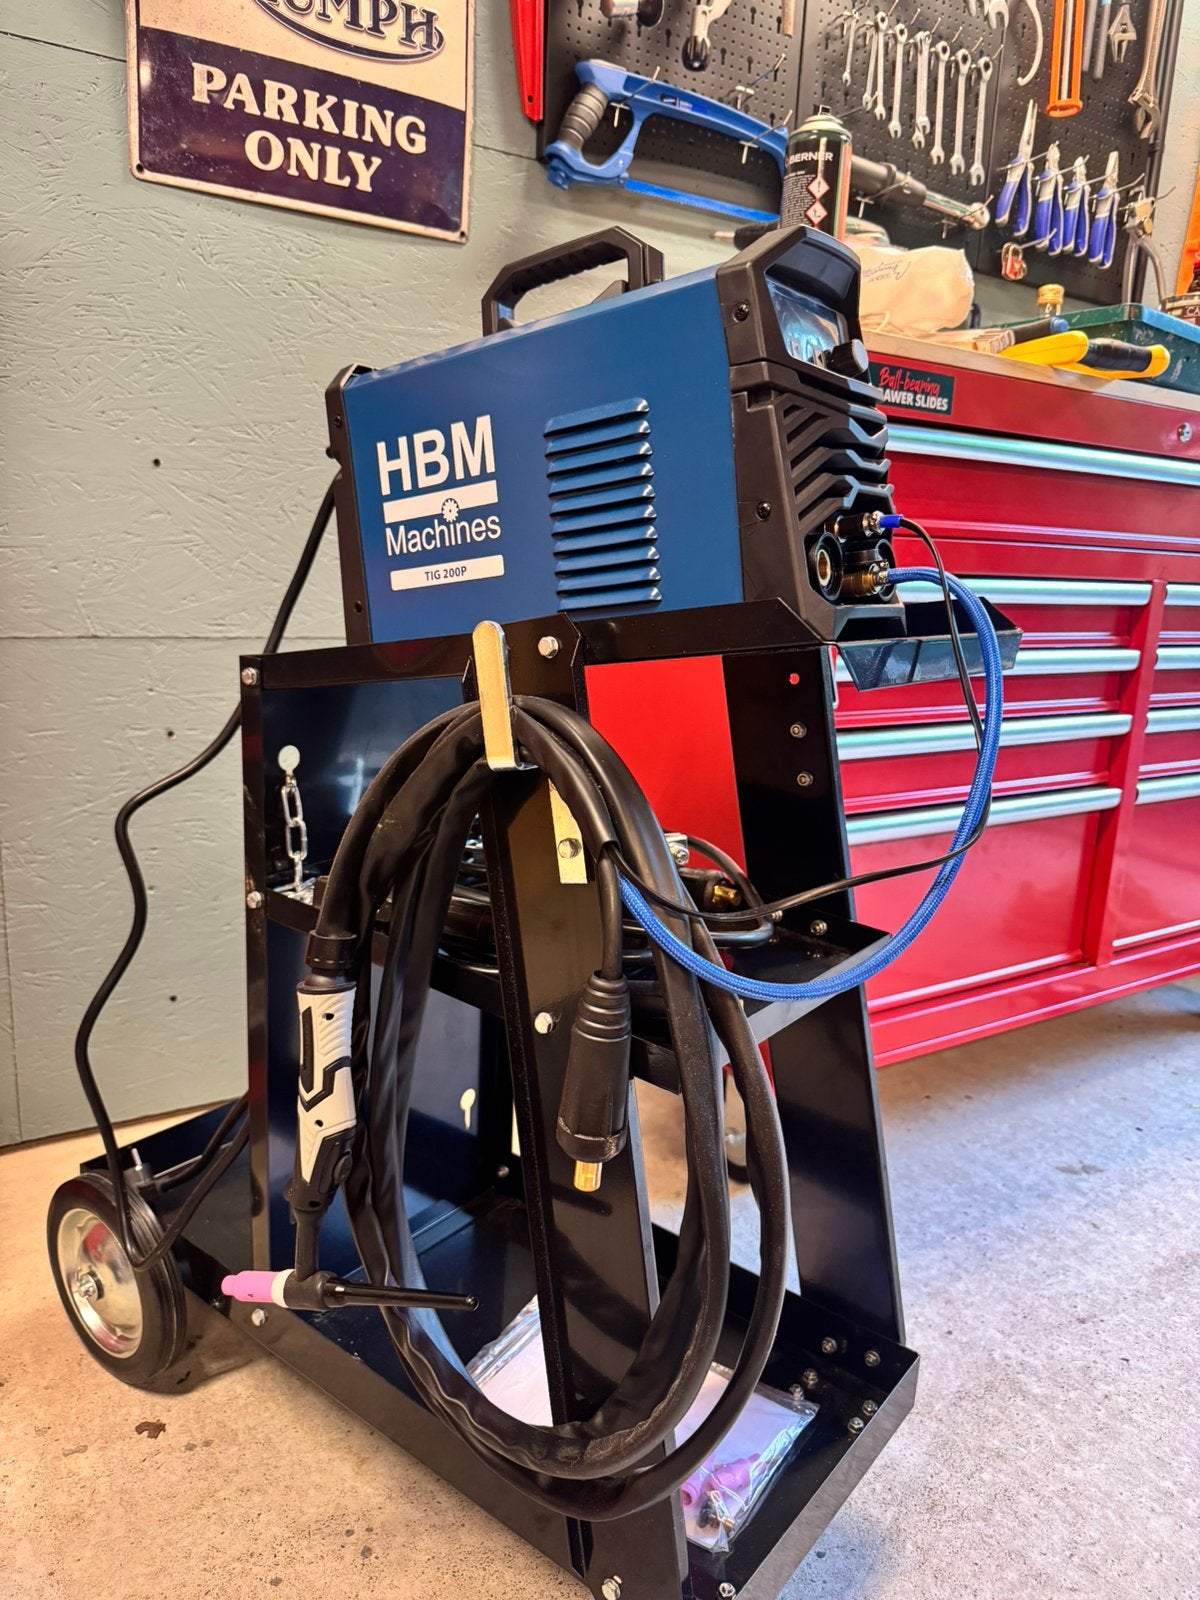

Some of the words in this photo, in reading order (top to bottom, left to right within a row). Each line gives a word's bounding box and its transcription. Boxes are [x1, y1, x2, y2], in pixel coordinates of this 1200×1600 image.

[191, 61, 427, 155] PARKING
[244, 130, 382, 192] ONLY
[879, 367, 940, 396] Ball-bearing
[879, 387, 914, 406] AWER
[914, 394, 948, 411] SLIDES
[376, 414, 496, 496] HBM
[385, 515, 501, 557] Machines
[424, 570, 441, 581] TIG
[443, 566, 467, 579] 200P
